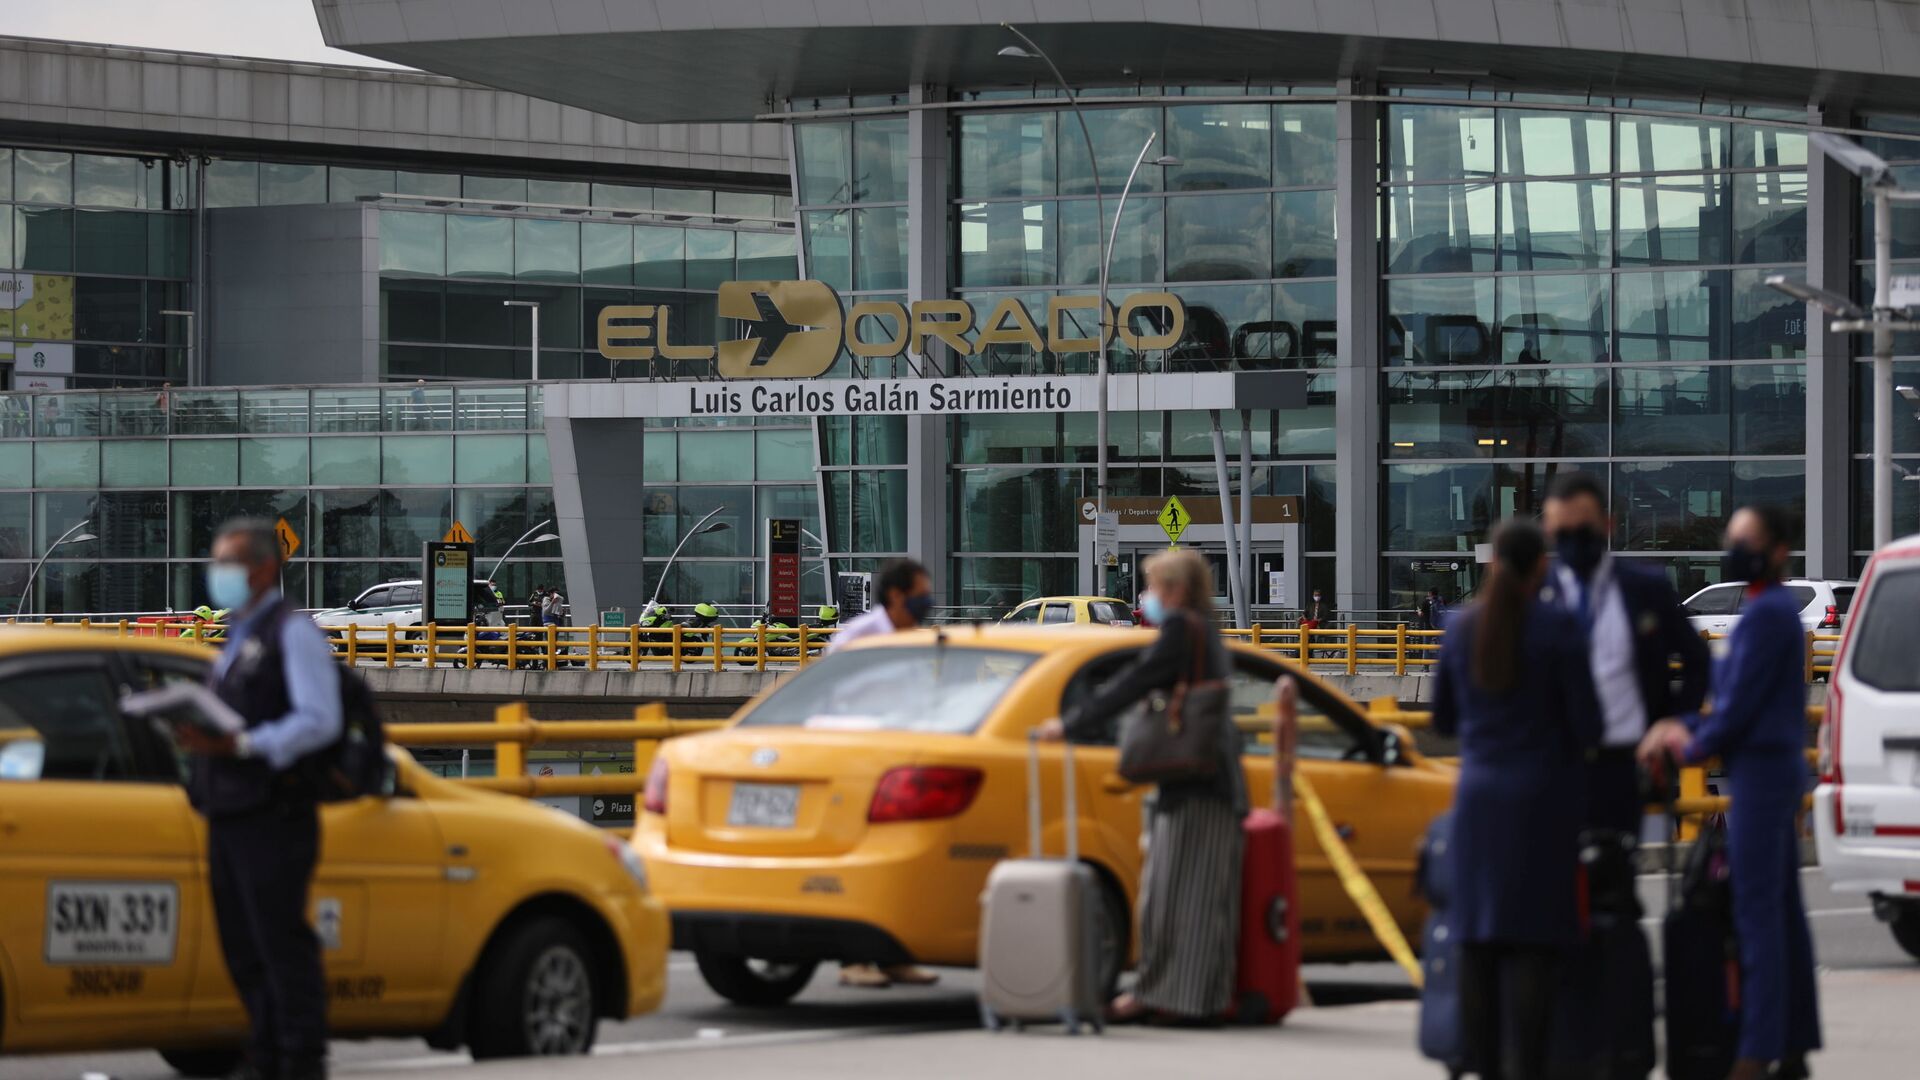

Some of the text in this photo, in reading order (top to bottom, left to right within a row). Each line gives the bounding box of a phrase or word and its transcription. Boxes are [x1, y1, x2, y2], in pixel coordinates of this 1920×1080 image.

[598, 304, 716, 360] EL
[718, 280, 1188, 378] DORADO
[690, 382, 1072, 414] Luis Carlos Galán Sarmiento
[1282, 503, 1292, 517] 1
[773, 520, 783, 538] 1
[611, 802, 632, 813] Plaza
[55, 894, 170, 934] SXN 331
